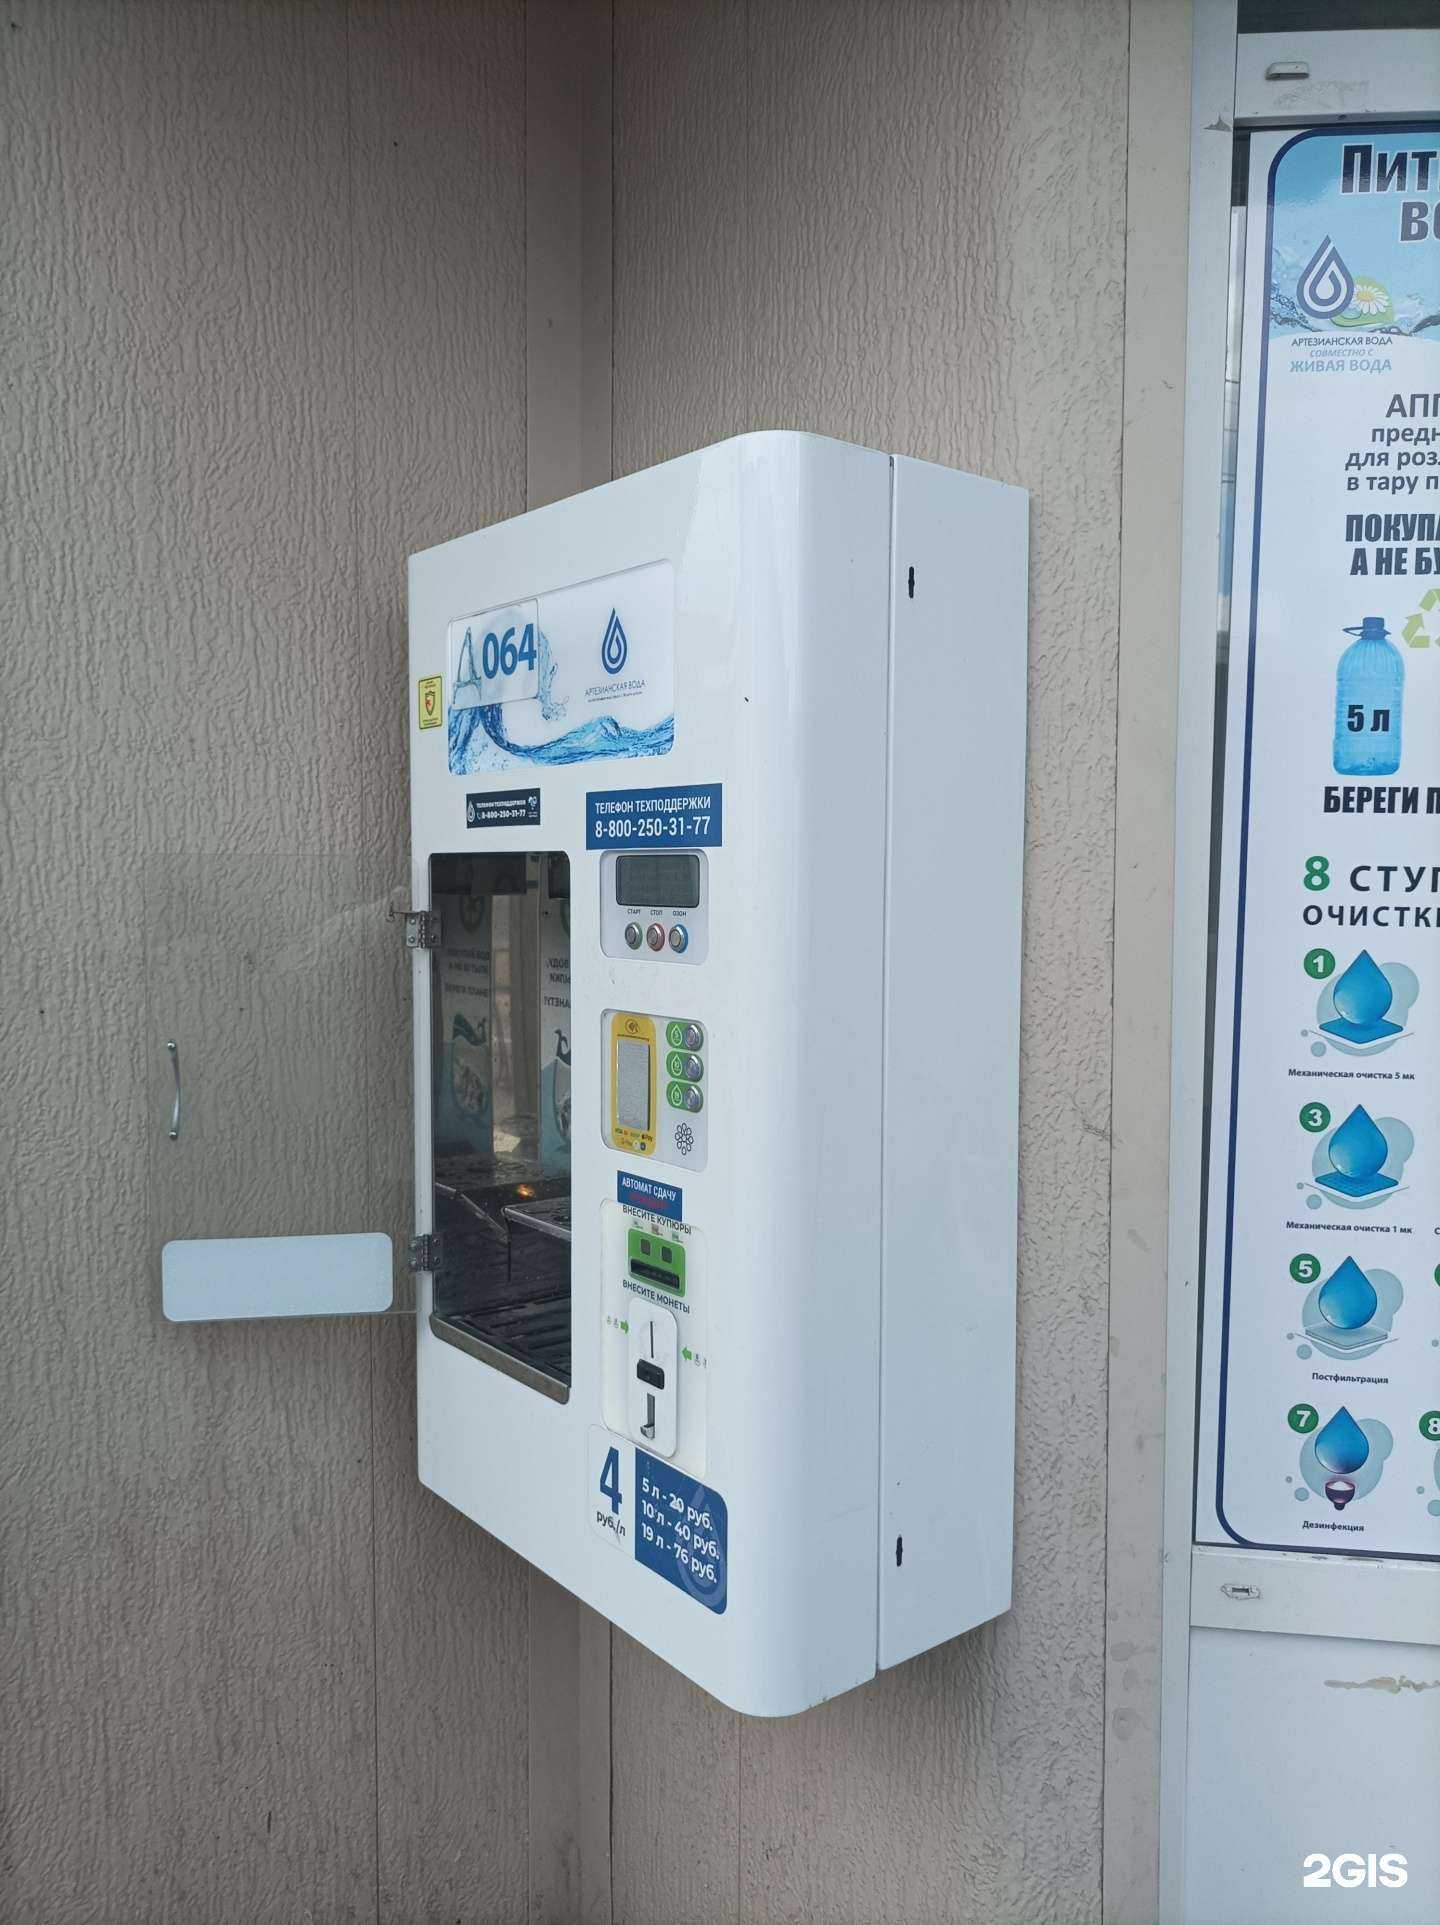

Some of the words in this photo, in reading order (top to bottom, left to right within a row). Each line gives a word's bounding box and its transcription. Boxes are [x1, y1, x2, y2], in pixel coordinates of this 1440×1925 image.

[1291, 337, 1363, 346] АРТЕЗИАНСКАЯ
[1365, 336, 1393, 345] ВОДА
[1290, 360, 1345, 372] ЖИВАЯ
[1349, 359, 1392, 374] ВОДА
[1345, 452, 1389, 471] для
[1397, 451, 1440, 471] роз
[1347, 477, 1359, 491] в
[1366, 475, 1419, 494] тару
[1345, 513, 1440, 542] ПОКУП
[1350, 548, 1368, 575] А
[1375, 548, 1408, 575] НЕ
[1347, 704, 1364, 732] 5
[595, 801, 634, 814] ТЕЛЕФОН
[635, 796, 711, 813] ТЕХПОДДЕРЖКИ
[1323, 786, 1419, 814] БЕРЕГИ
[595, 815, 711, 838] 8-800-250-31-77
[1303, 855, 1331, 891] 8
[1302, 905, 1440, 927] ОЧИСТК
[1312, 955, 1325, 973] 1
[1288, 1068, 1354, 1078] Механическая
[1355, 1071, 1393, 1079] очистка
[1308, 1108, 1323, 1126] 3
[621, 1177, 654, 1194] АВТОМАТ
[653, 1186, 677, 1201] СДАЧУ
[622, 1204, 656, 1222] ВНЕСИТЕ
[656, 1216, 692, 1235] КУПЮРЫ
[1285, 1221, 1352, 1232] Механическая
[1353, 1224, 1391, 1233] очистка
[1399, 1226, 1413, 1234] мк
[1298, 1260, 1313, 1278] 5
[622, 1279, 656, 1300] ВНЕСИТЕ
[656, 1293, 690, 1314] МОНЕТЫ
[1312, 1372, 1389, 1384] Постфильтрация
[1296, 1410, 1311, 1427] 7
[600, 1446, 622, 1515] 4
[642, 1477, 650, 1492] 5
[652, 1487, 660, 1499] л
[687, 1506, 713, 1531] руб.
[642, 1500, 654, 1518] 10
[656, 1513, 665, 1526] л
[674, 1521, 691, 1541] 40
[694, 1533, 720, 1560] руб.
[1302, 1520, 1365, 1532] Дезинфекция
[642, 1523, 654, 1541] 19
[656, 1537, 664, 1549] л
[673, 1543, 689, 1564] 76
[691, 1557, 717, 1583] руб.
